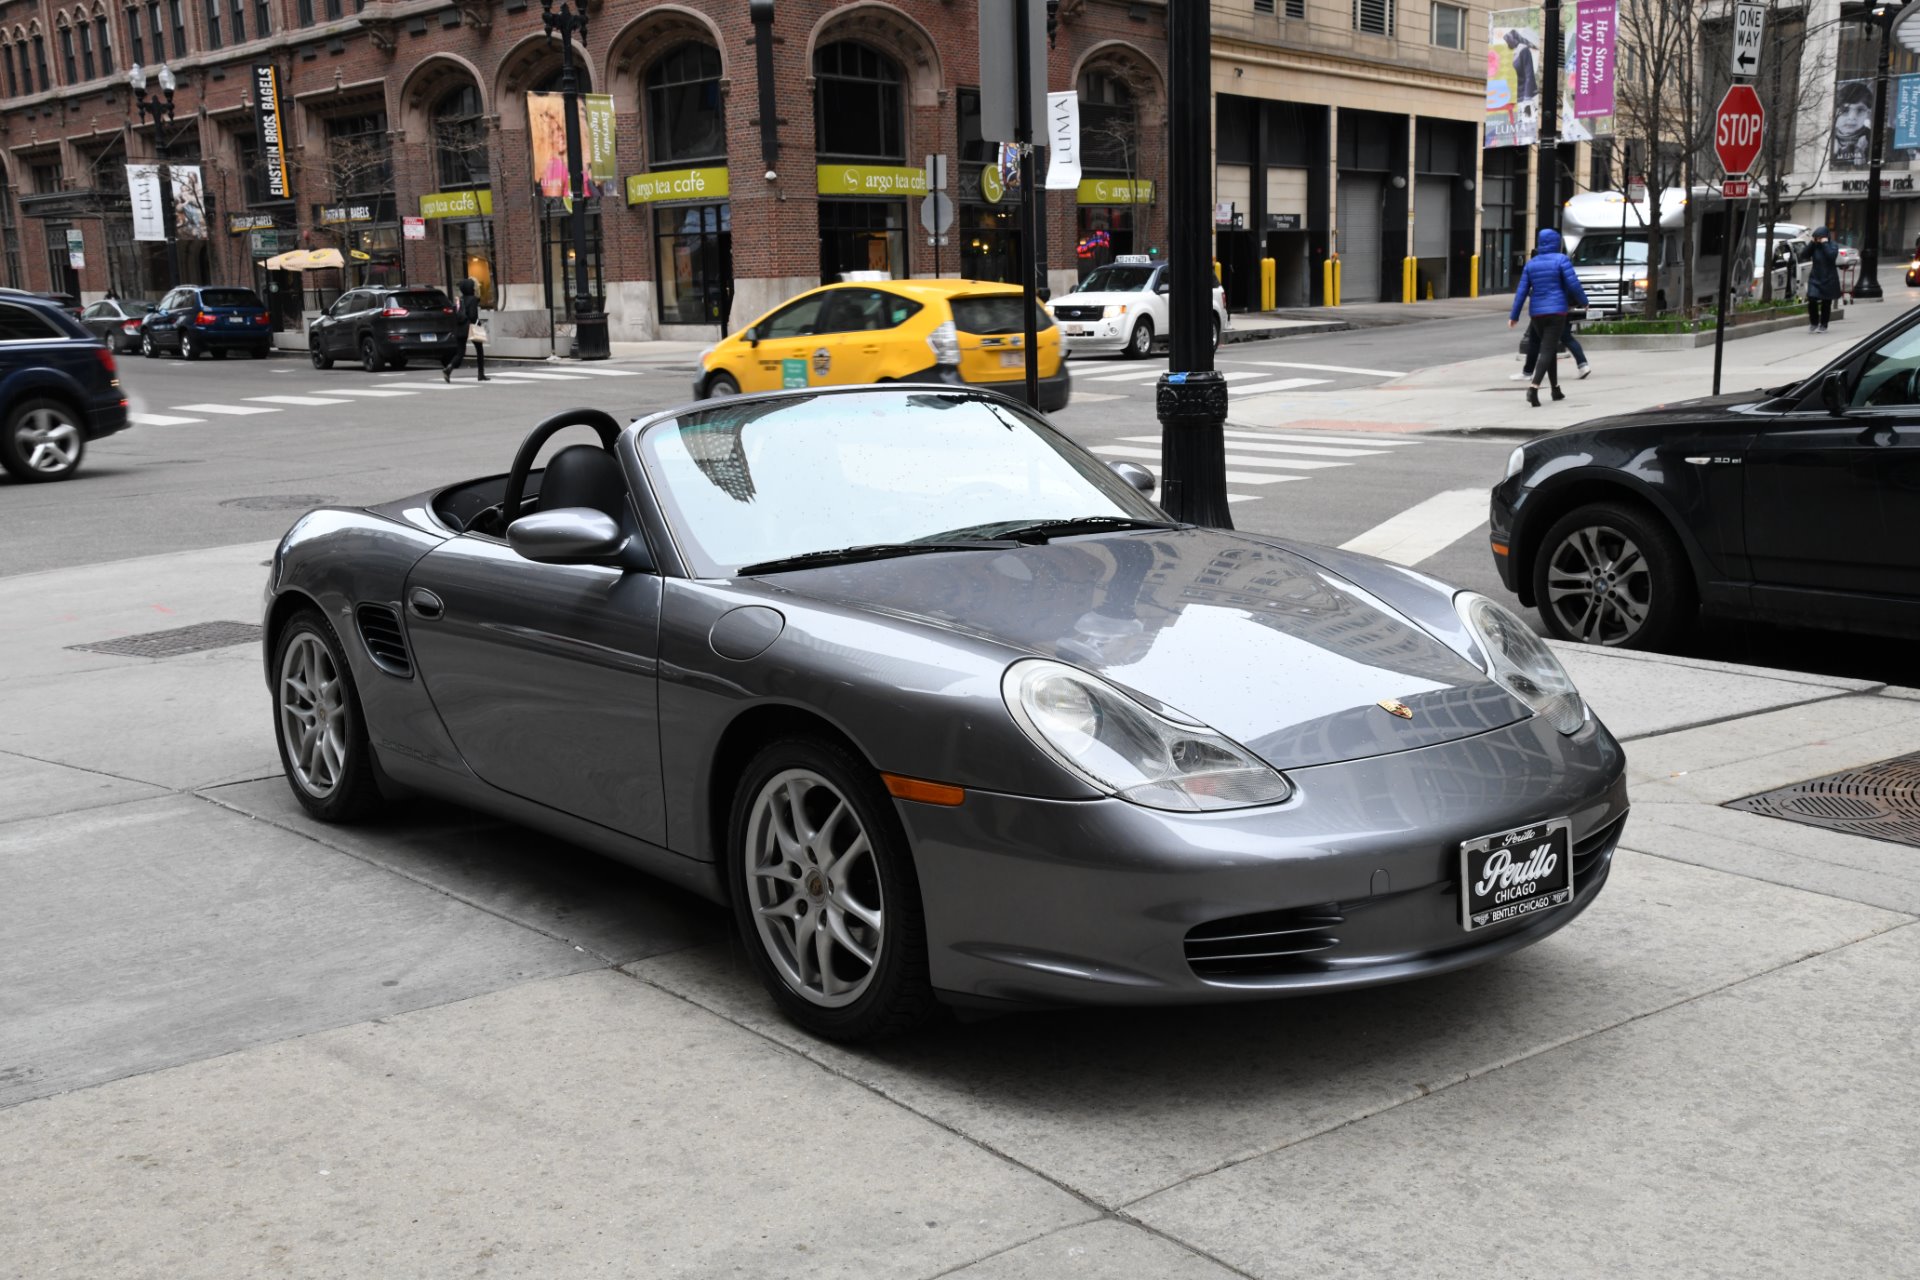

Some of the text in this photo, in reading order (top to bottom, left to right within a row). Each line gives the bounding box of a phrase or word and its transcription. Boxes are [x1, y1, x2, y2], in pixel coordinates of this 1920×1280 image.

[1739, 9, 1761, 28] ONE
[1579, 21, 1593, 42] My
[1596, 20, 1609, 44] Her
[1737, 30, 1760, 48] WAY
[1580, 45, 1593, 95] Dreams
[1593, 47, 1608, 84] Story,
[258, 68, 275, 110] BAGELS
[590, 111, 603, 163] Englewood
[600, 111, 612, 156] Everyday
[1055, 98, 1073, 165] LUMA
[1718, 113, 1761, 146] STOP
[269, 145, 284, 195] EINSTEIN
[1892, 174, 1914, 190] rack
[655, 179, 671, 194] tea
[673, 171, 705, 192] café
[865, 175, 893, 193] argo
[895, 174, 909, 189] tea
[1724, 184, 1746, 196] ALL WAY
[450, 192, 474, 211] café
[1501, 829, 1536, 847] Perillo
[1474, 843, 1558, 897] Perillo
[1494, 881, 1537, 904] CHICAGO
[1492, 896, 1549, 922] BENTLEY CHICAGO
